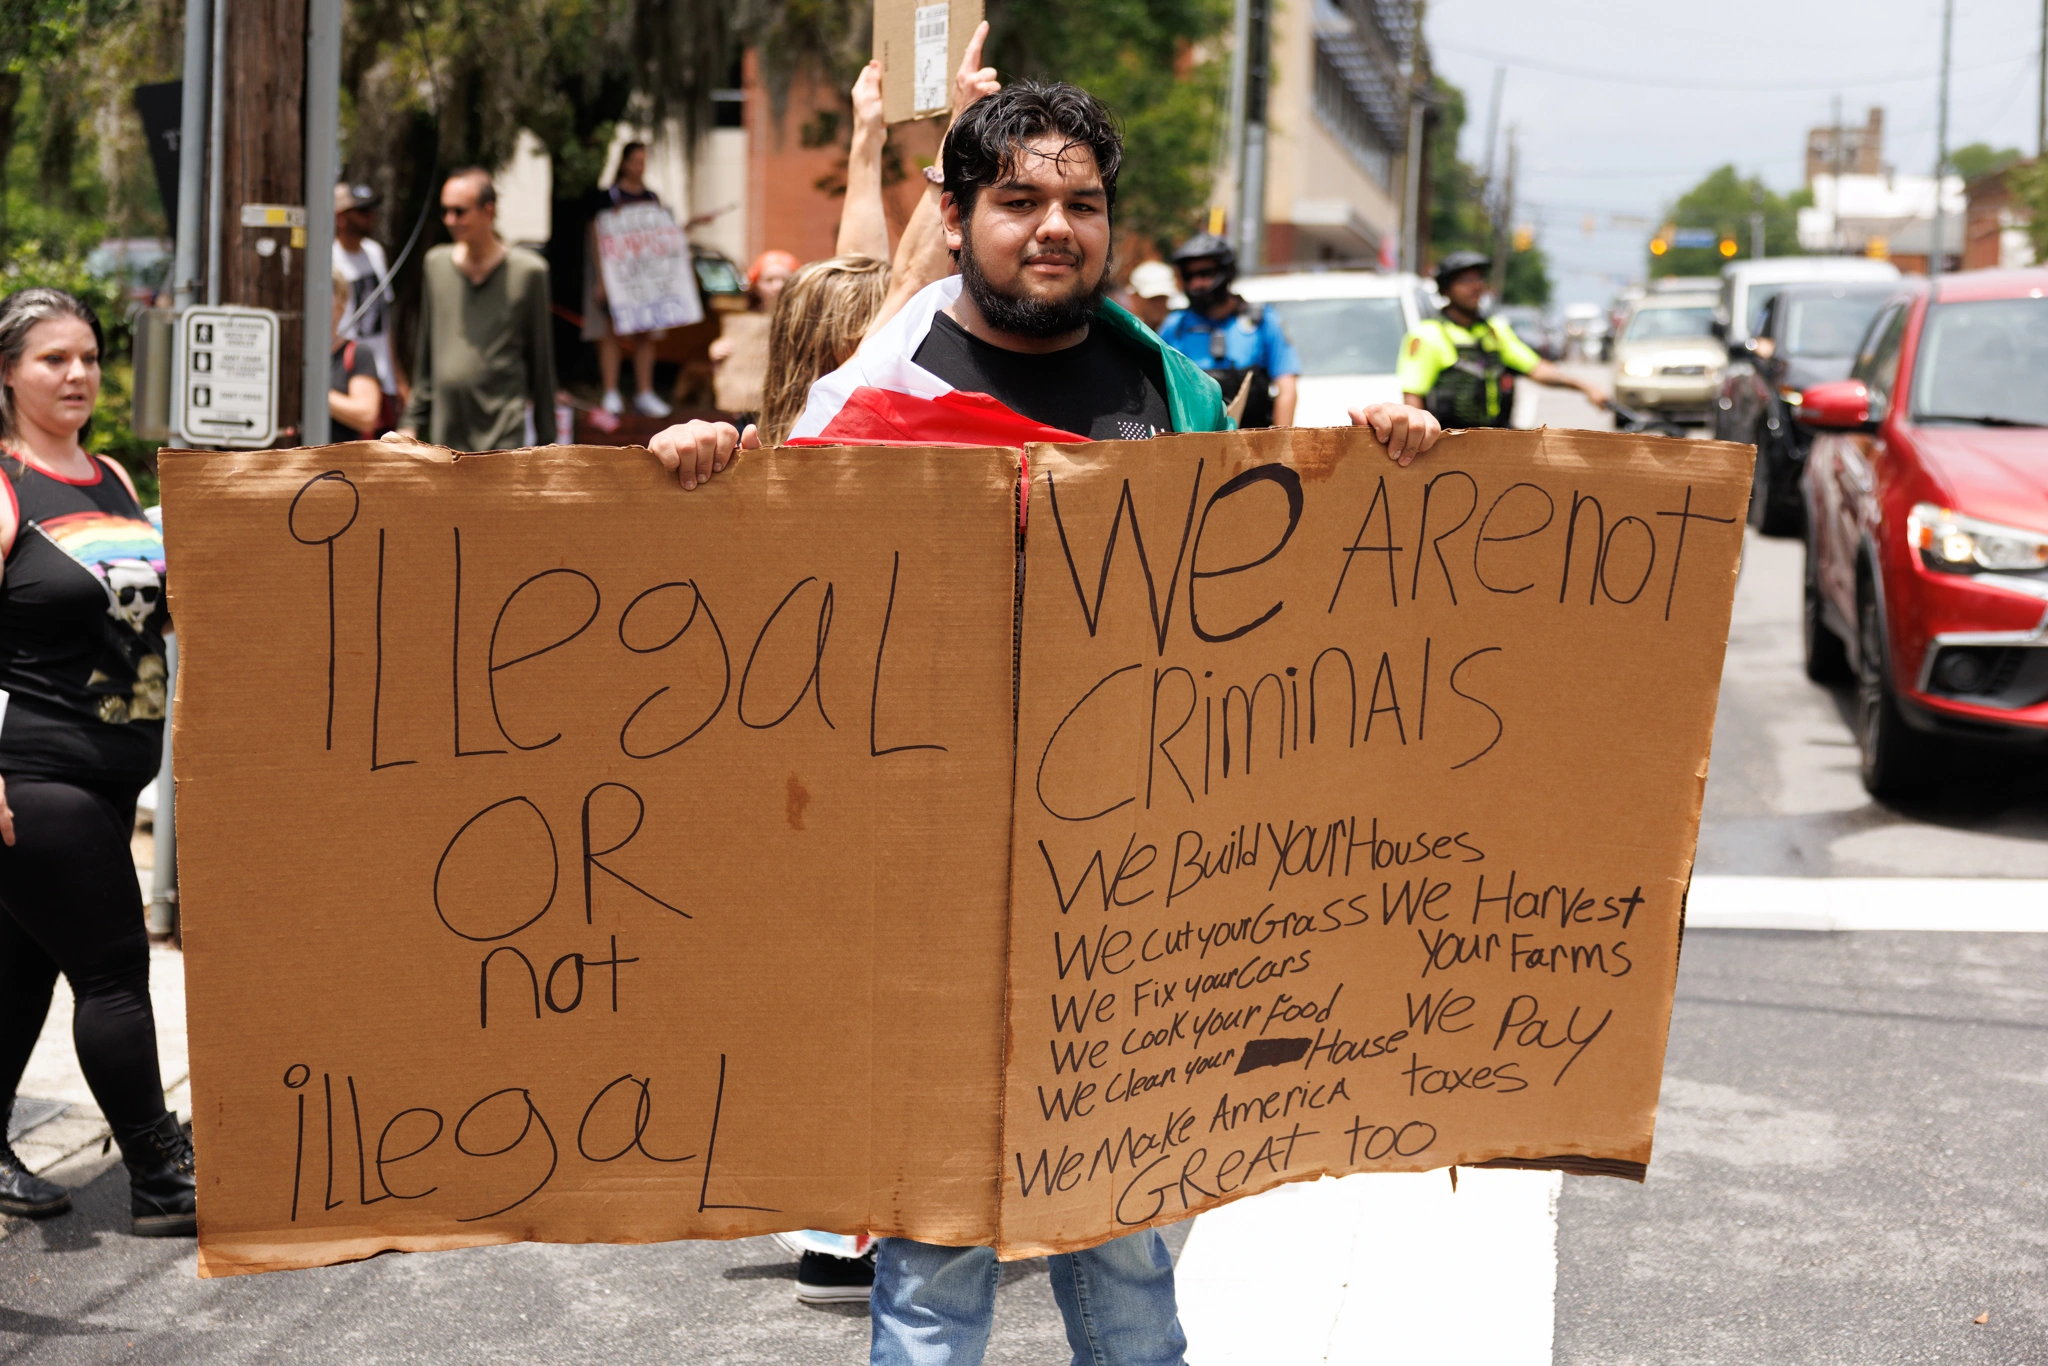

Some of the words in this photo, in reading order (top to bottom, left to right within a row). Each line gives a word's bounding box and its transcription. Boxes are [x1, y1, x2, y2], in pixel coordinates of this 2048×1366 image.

[1047, 457, 1304, 657] We
[1560, 484, 1736, 622] not
[434, 782, 693, 942] OR
[1037, 831, 1158, 915] We
[1165, 822, 1262, 908] Build
[1344, 815, 1486, 878] Houses
[1382, 876, 1452, 926] We
[1471, 869, 1647, 930] Harvest
[480, 934, 641, 1030] not
[1053, 924, 1136, 982] We
[1197, 917, 1254, 960] your
[1511, 932, 1633, 978] Farms
[1051, 988, 1116, 1034] We
[1134, 978, 1178, 1018] Fix
[1184, 967, 1240, 1003] your
[1406, 987, 1476, 1036] We
[1492, 994, 1613, 1087] Pay
[1036, 1080, 1098, 1124] We
[1183, 1046, 1236, 1086] your
[1303, 1026, 1410, 1071] House
[1049, 1038, 1109, 1076] We
[1400, 1051, 1530, 1097] taxes
[1015, 1148, 1086, 1199] We
[1086, 1105, 1197, 1184] Make
